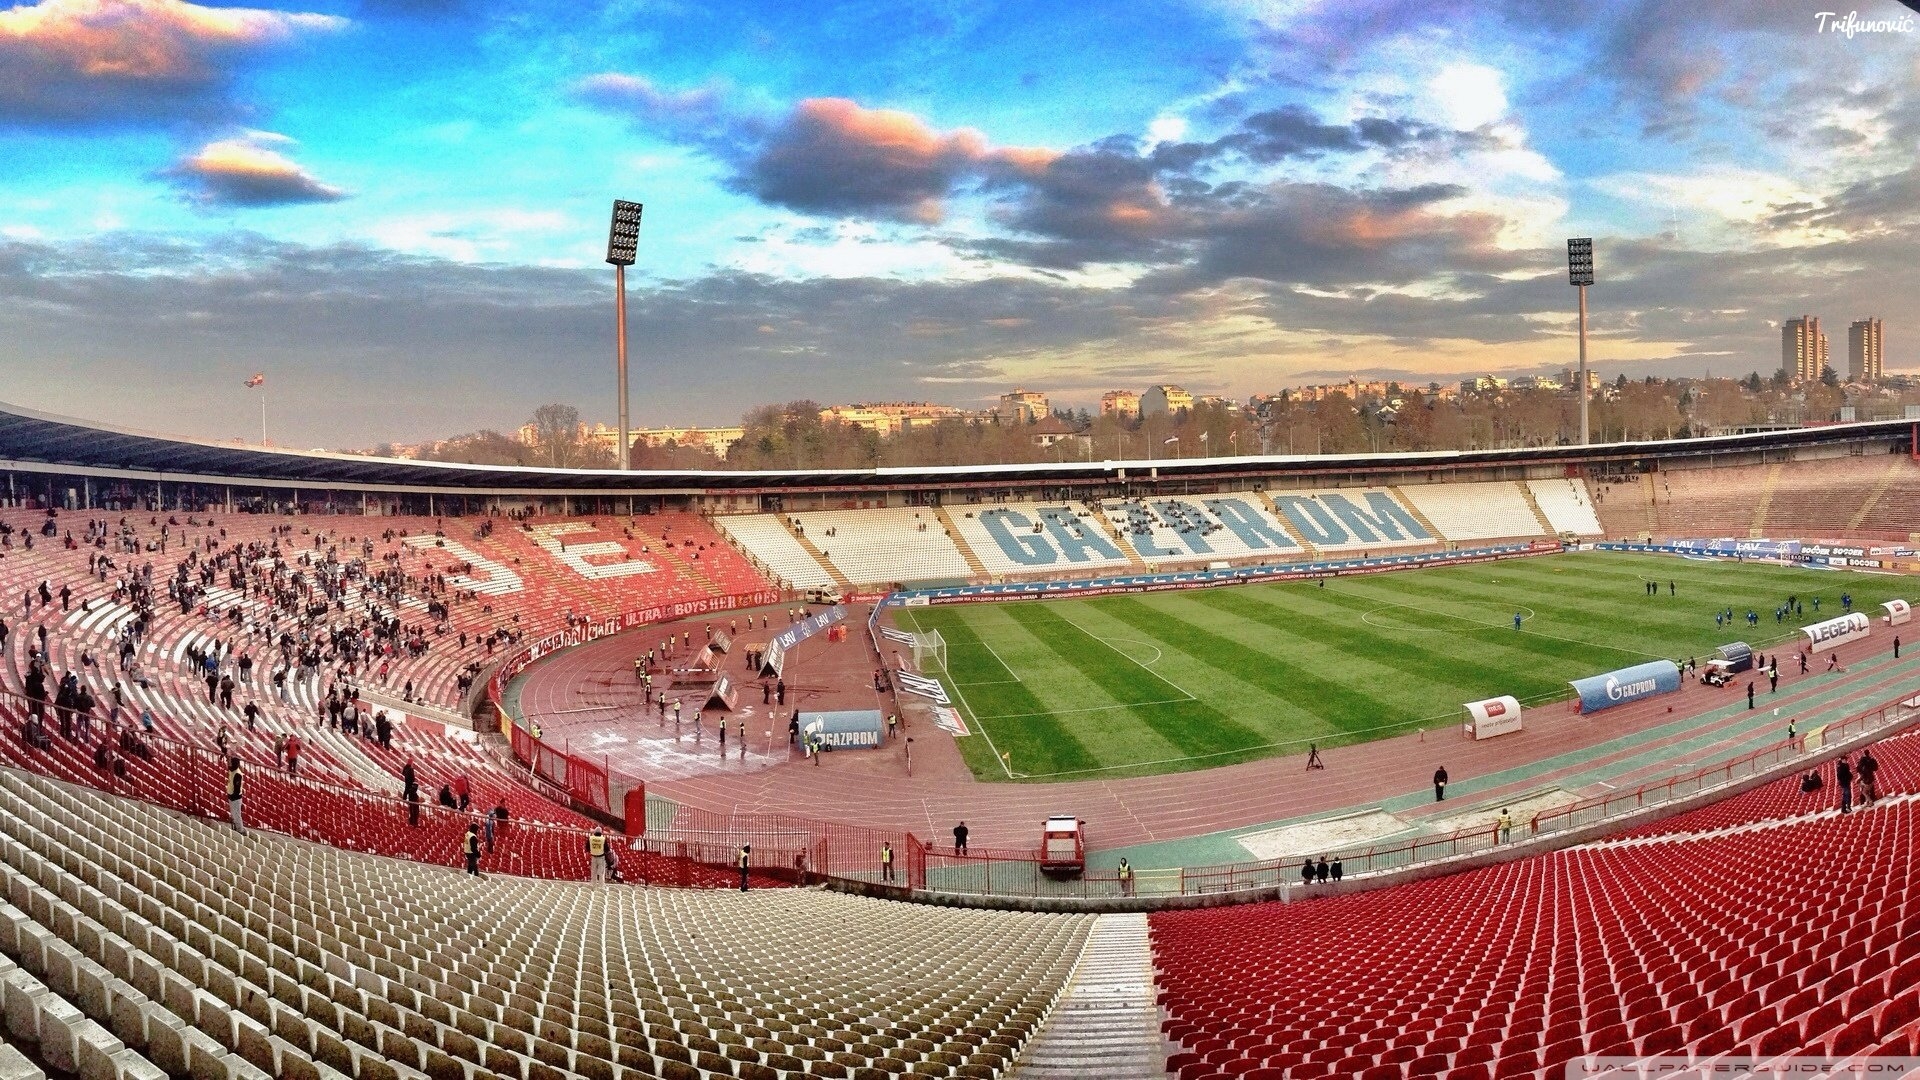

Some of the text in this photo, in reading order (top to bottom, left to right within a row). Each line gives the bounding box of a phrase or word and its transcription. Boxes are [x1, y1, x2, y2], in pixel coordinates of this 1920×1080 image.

[977, 486, 1438, 565] GAZPROM
[1849, 559, 1880, 568] SOCCER
[625, 608, 662, 626] ULTRA
[674, 600, 708, 616] BOYS
[815, 613, 829, 628] LAV
[780, 630, 797, 648] LAV
[1811, 619, 1857, 644] LEGEA
[1623, 679, 1656, 698] GAZPROM
[826, 731, 878, 746] GAZPROM
